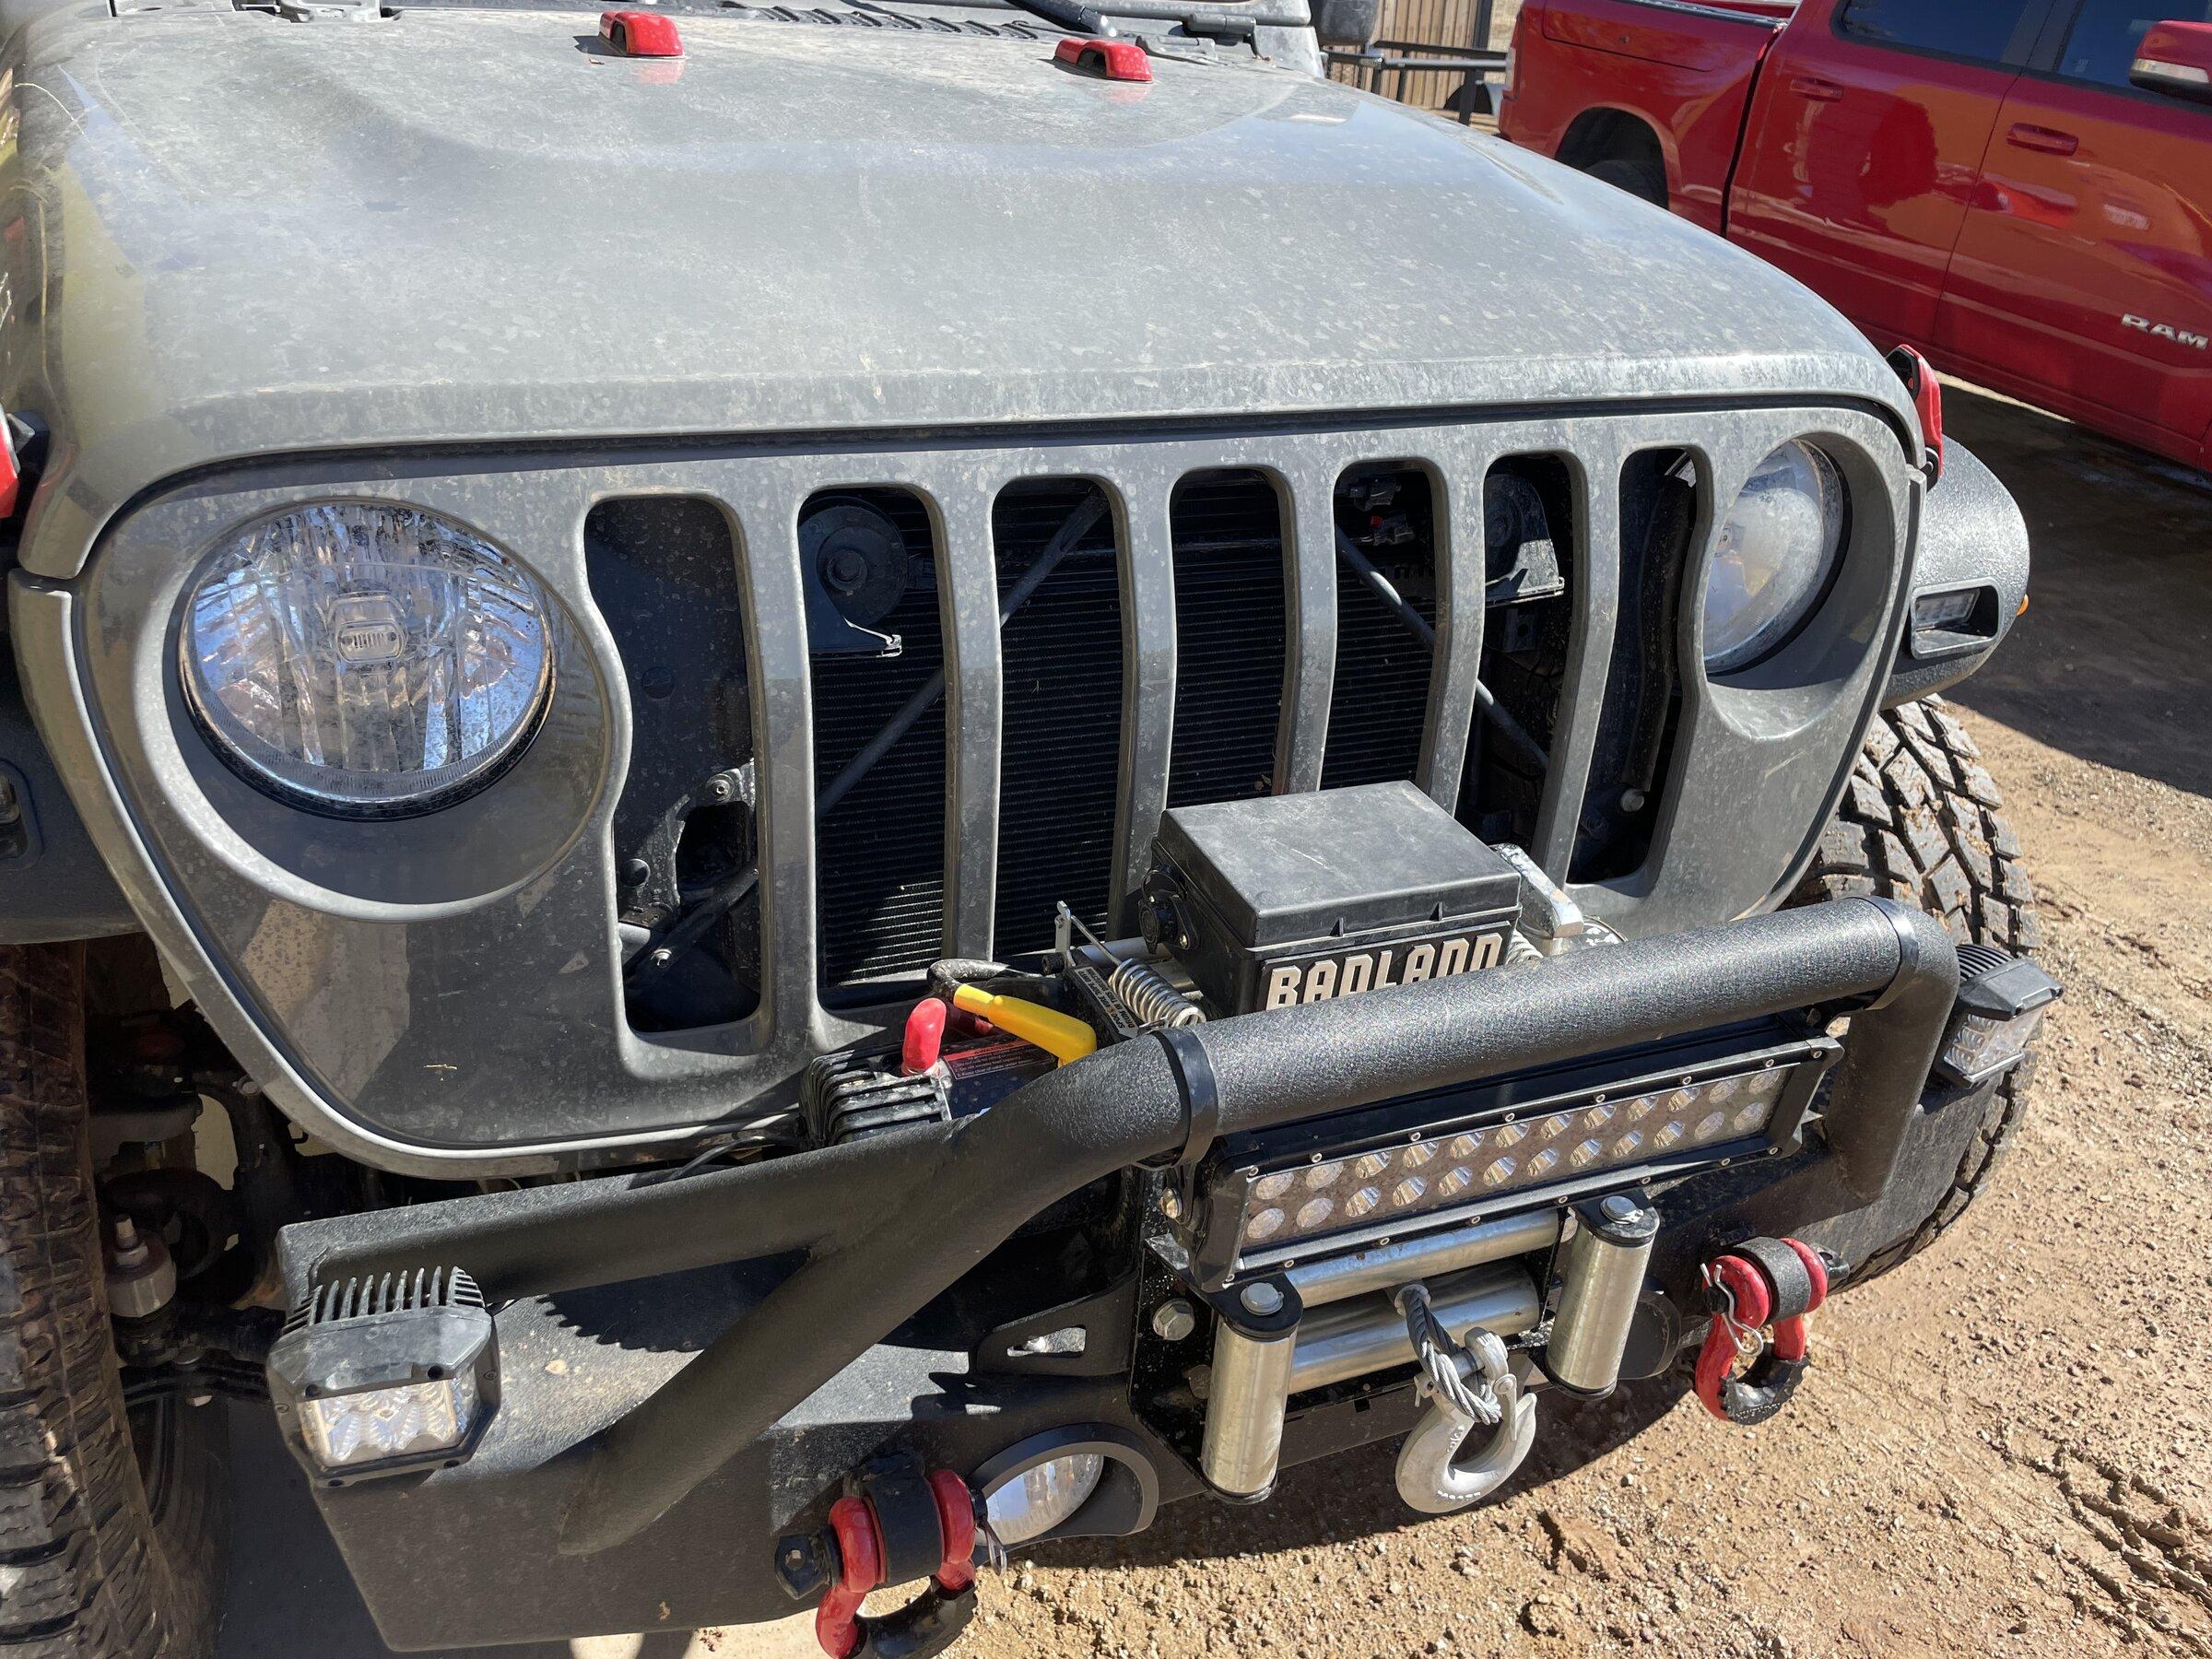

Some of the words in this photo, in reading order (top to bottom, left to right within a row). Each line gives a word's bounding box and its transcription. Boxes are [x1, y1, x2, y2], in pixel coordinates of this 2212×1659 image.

[2121, 312, 2209, 350] RAM
[1106, 991, 1118, 1004] THIS
[1118, 1010, 1135, 1029] DRUM
